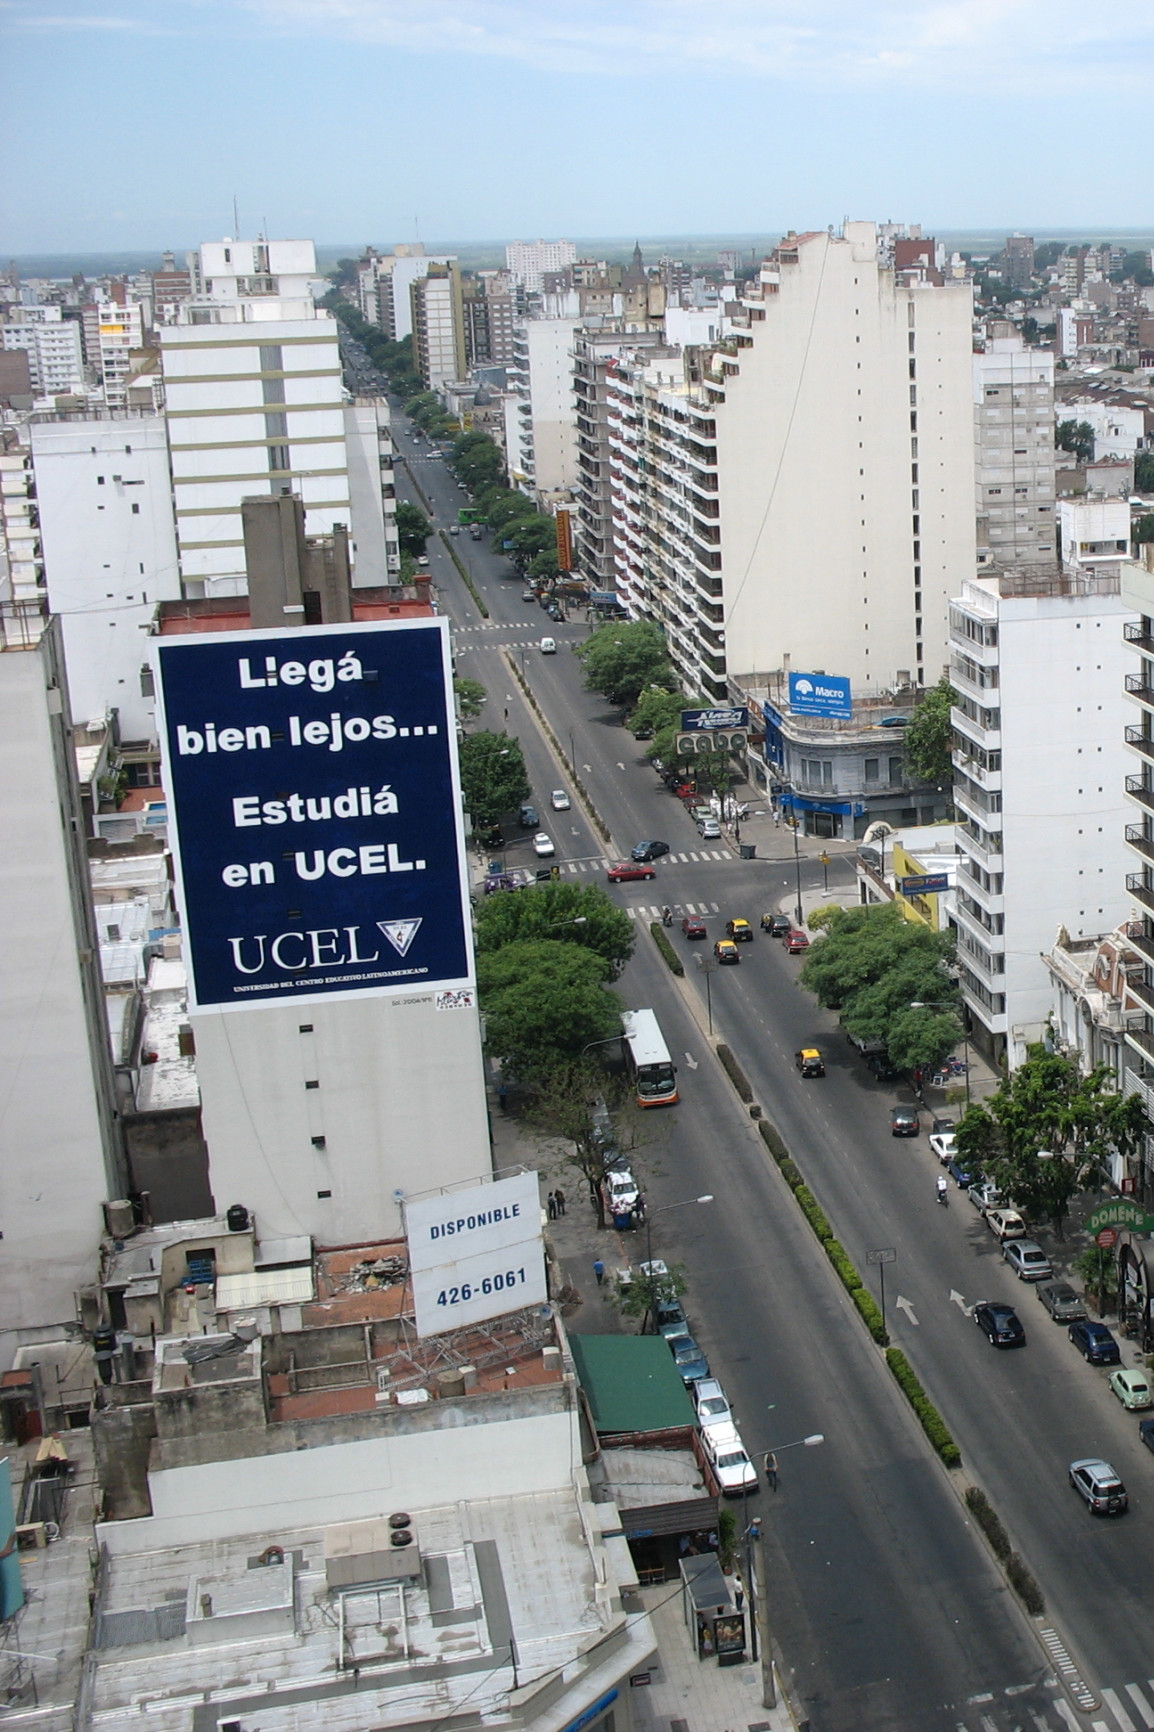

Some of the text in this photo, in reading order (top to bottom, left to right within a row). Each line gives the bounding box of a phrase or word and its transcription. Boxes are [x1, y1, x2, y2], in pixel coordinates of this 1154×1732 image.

[238, 650, 364, 693] Llegá
[815, 686, 845, 699] Macro
[177, 711, 439, 756] bien lejos...
[232, 784, 400, 828] Estudiá
[222, 842, 427, 888] en UCEL.
[228, 926, 379, 974] UCEL
[233, 982, 280, 993] UNIVERSIDAD
[280, 980, 295, 989] DEL
[295, 977, 325, 987] CENTRO
[430, 1203, 521, 1240] DISPONIBLE
[437, 1267, 527, 1307] 426-6061
